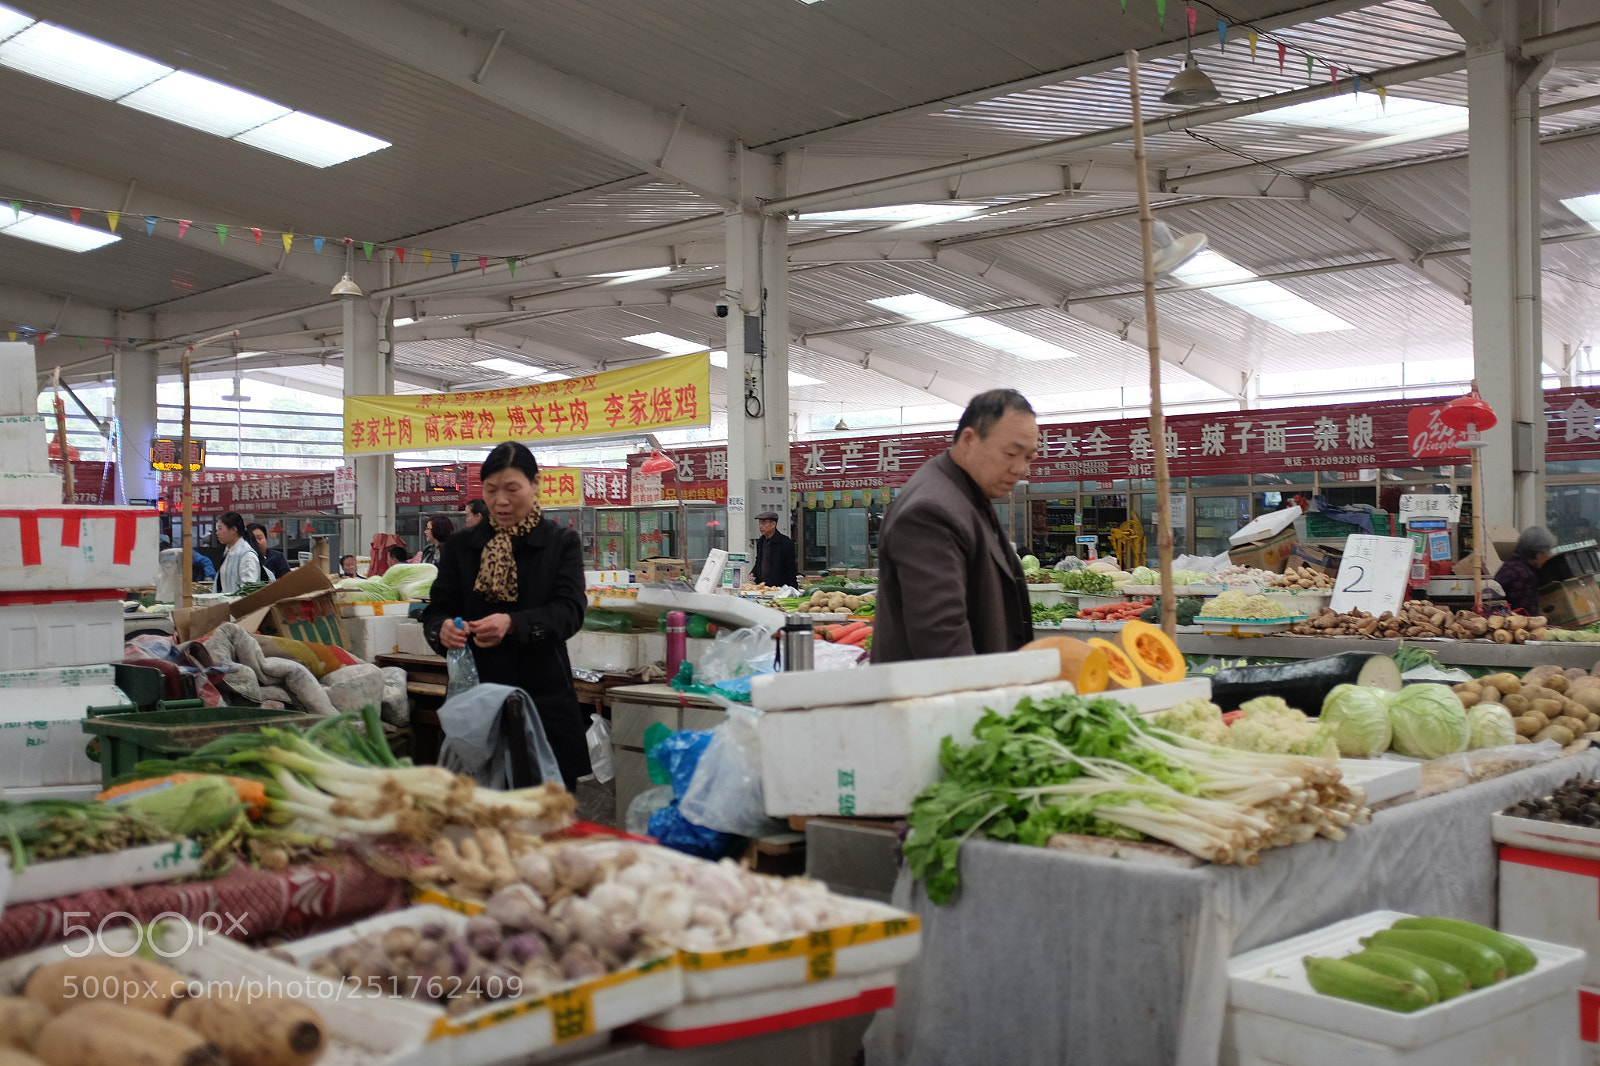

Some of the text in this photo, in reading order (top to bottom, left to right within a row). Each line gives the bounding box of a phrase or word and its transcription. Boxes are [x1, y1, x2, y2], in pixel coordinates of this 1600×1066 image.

[351, 414, 412, 447] 李家牛肉
[507, 398, 589, 436] 博文牛肉
[604, 383, 697, 428] 李家烧鸡
[1201, 420, 1286, 457] 辣子面
[1313, 414, 1374, 451] 杂粮
[803, 439, 901, 475] 水产店
[1310, 454, 1376, 466] 13209232066
[1342, 565, 1373, 592] 2
